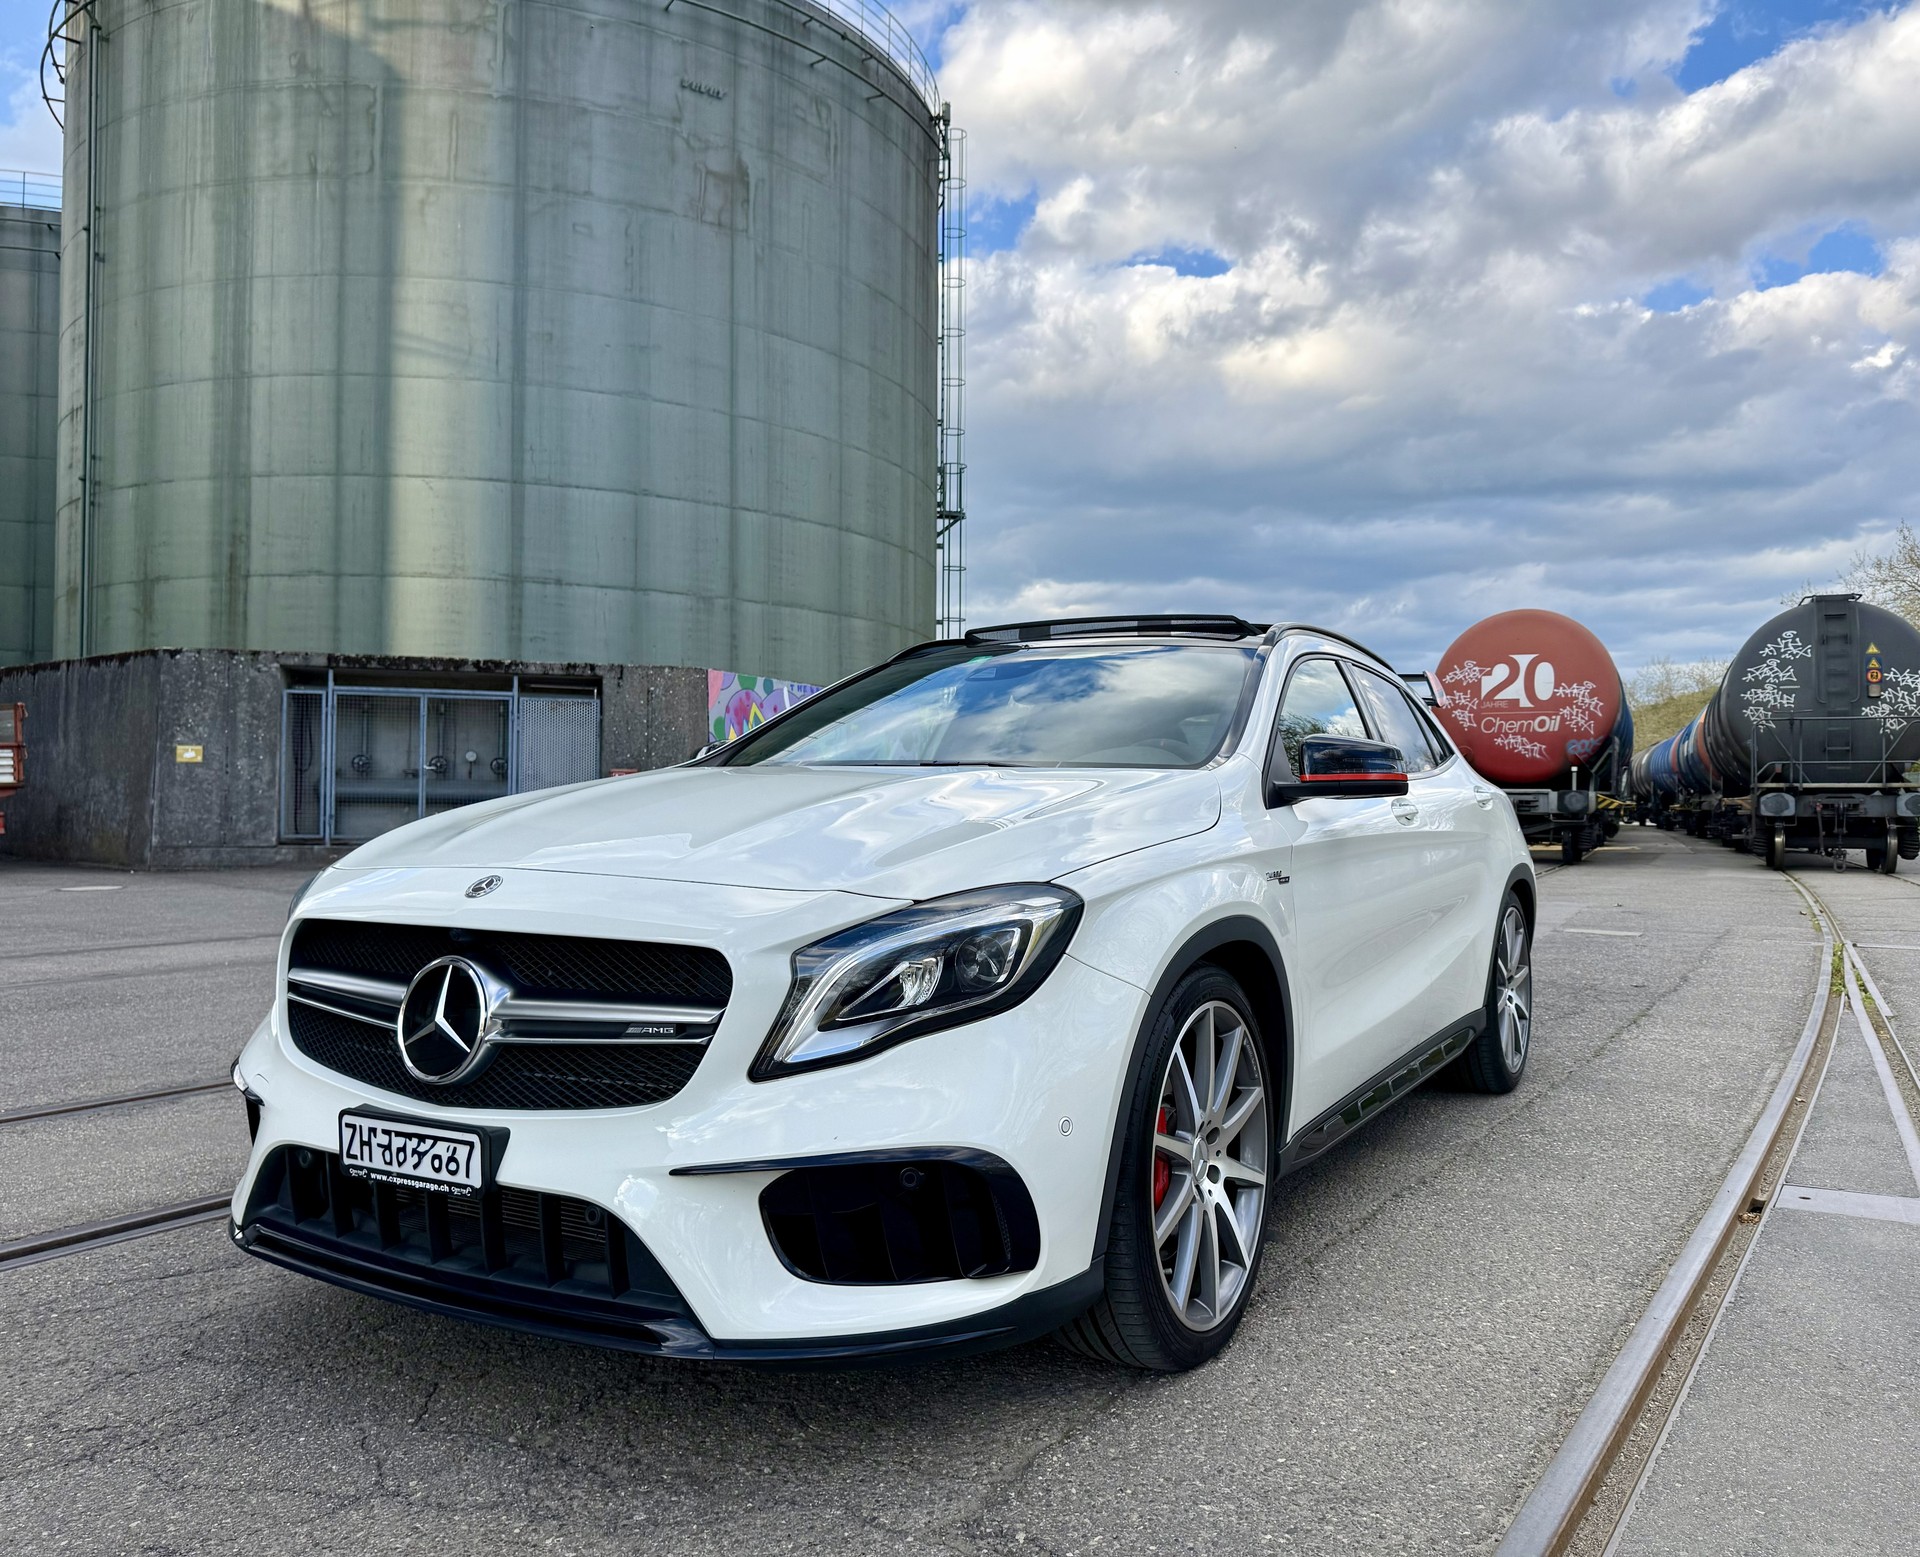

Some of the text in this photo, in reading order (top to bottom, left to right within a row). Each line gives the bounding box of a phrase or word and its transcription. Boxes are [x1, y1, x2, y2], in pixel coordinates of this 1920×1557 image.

[1480, 653, 1557, 708] 20
[1481, 700, 1510, 709] JAHRE
[1481, 715, 1561, 733] ChemOil
